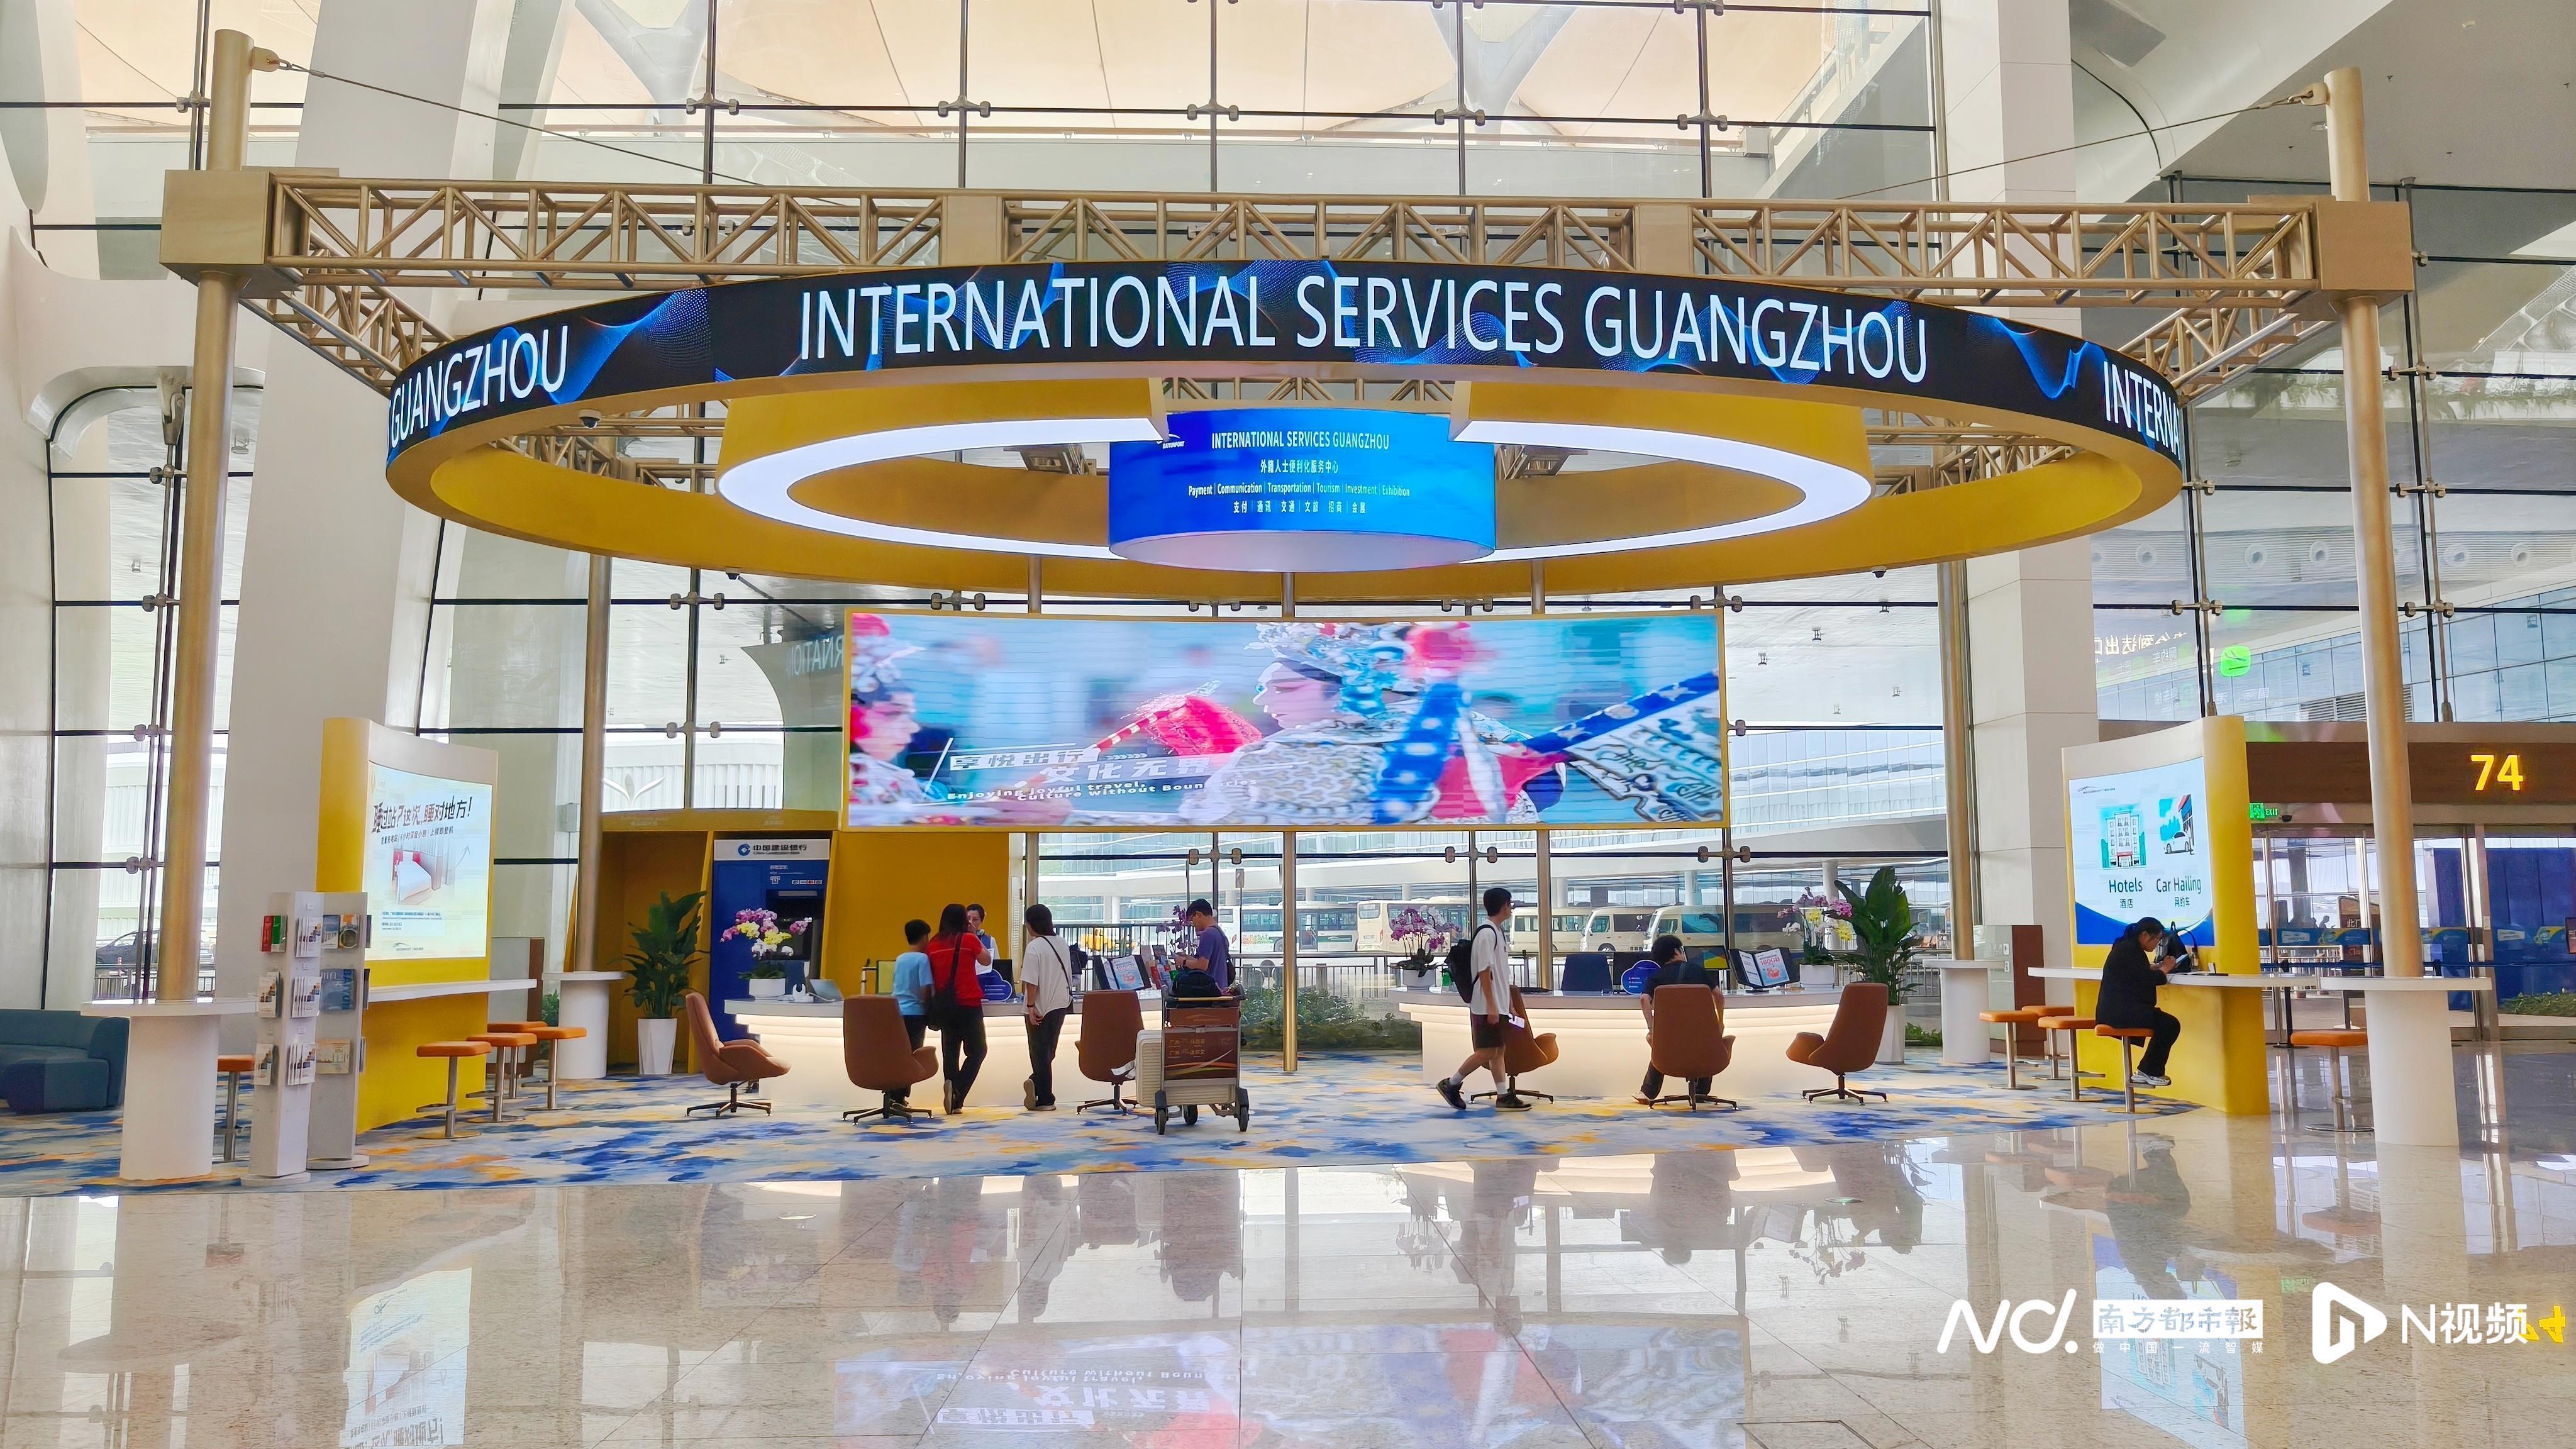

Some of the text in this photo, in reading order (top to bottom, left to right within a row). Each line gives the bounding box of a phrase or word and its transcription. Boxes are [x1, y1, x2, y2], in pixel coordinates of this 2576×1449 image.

[801, 275, 1928, 383] INTERNATIONAL SERVICES GUANGZHOU
[391, 325, 568, 448] GUANGZHOU
[2103, 360, 2180, 460] INTERNA
[1212, 431, 1389, 450] INTERNATIONAL SERVICES GUANGZHOU
[1188, 482, 1410, 498] Payment Communication Transportation Tourism Investment Exhibition
[1233, 501, 1248, 513] 支付
[1039, 757, 1210, 784] 文化无界
[2471, 754, 2524, 791] 74
[947, 789, 1024, 800] Enjoying
[1017, 791, 1082, 801] Culture
[2109, 877, 2143, 893] Hotels
[2156, 875, 2202, 894] Car Hailing
[2119, 899, 2133, 909] 酒店
[2174, 897, 2190, 908] 网约车
